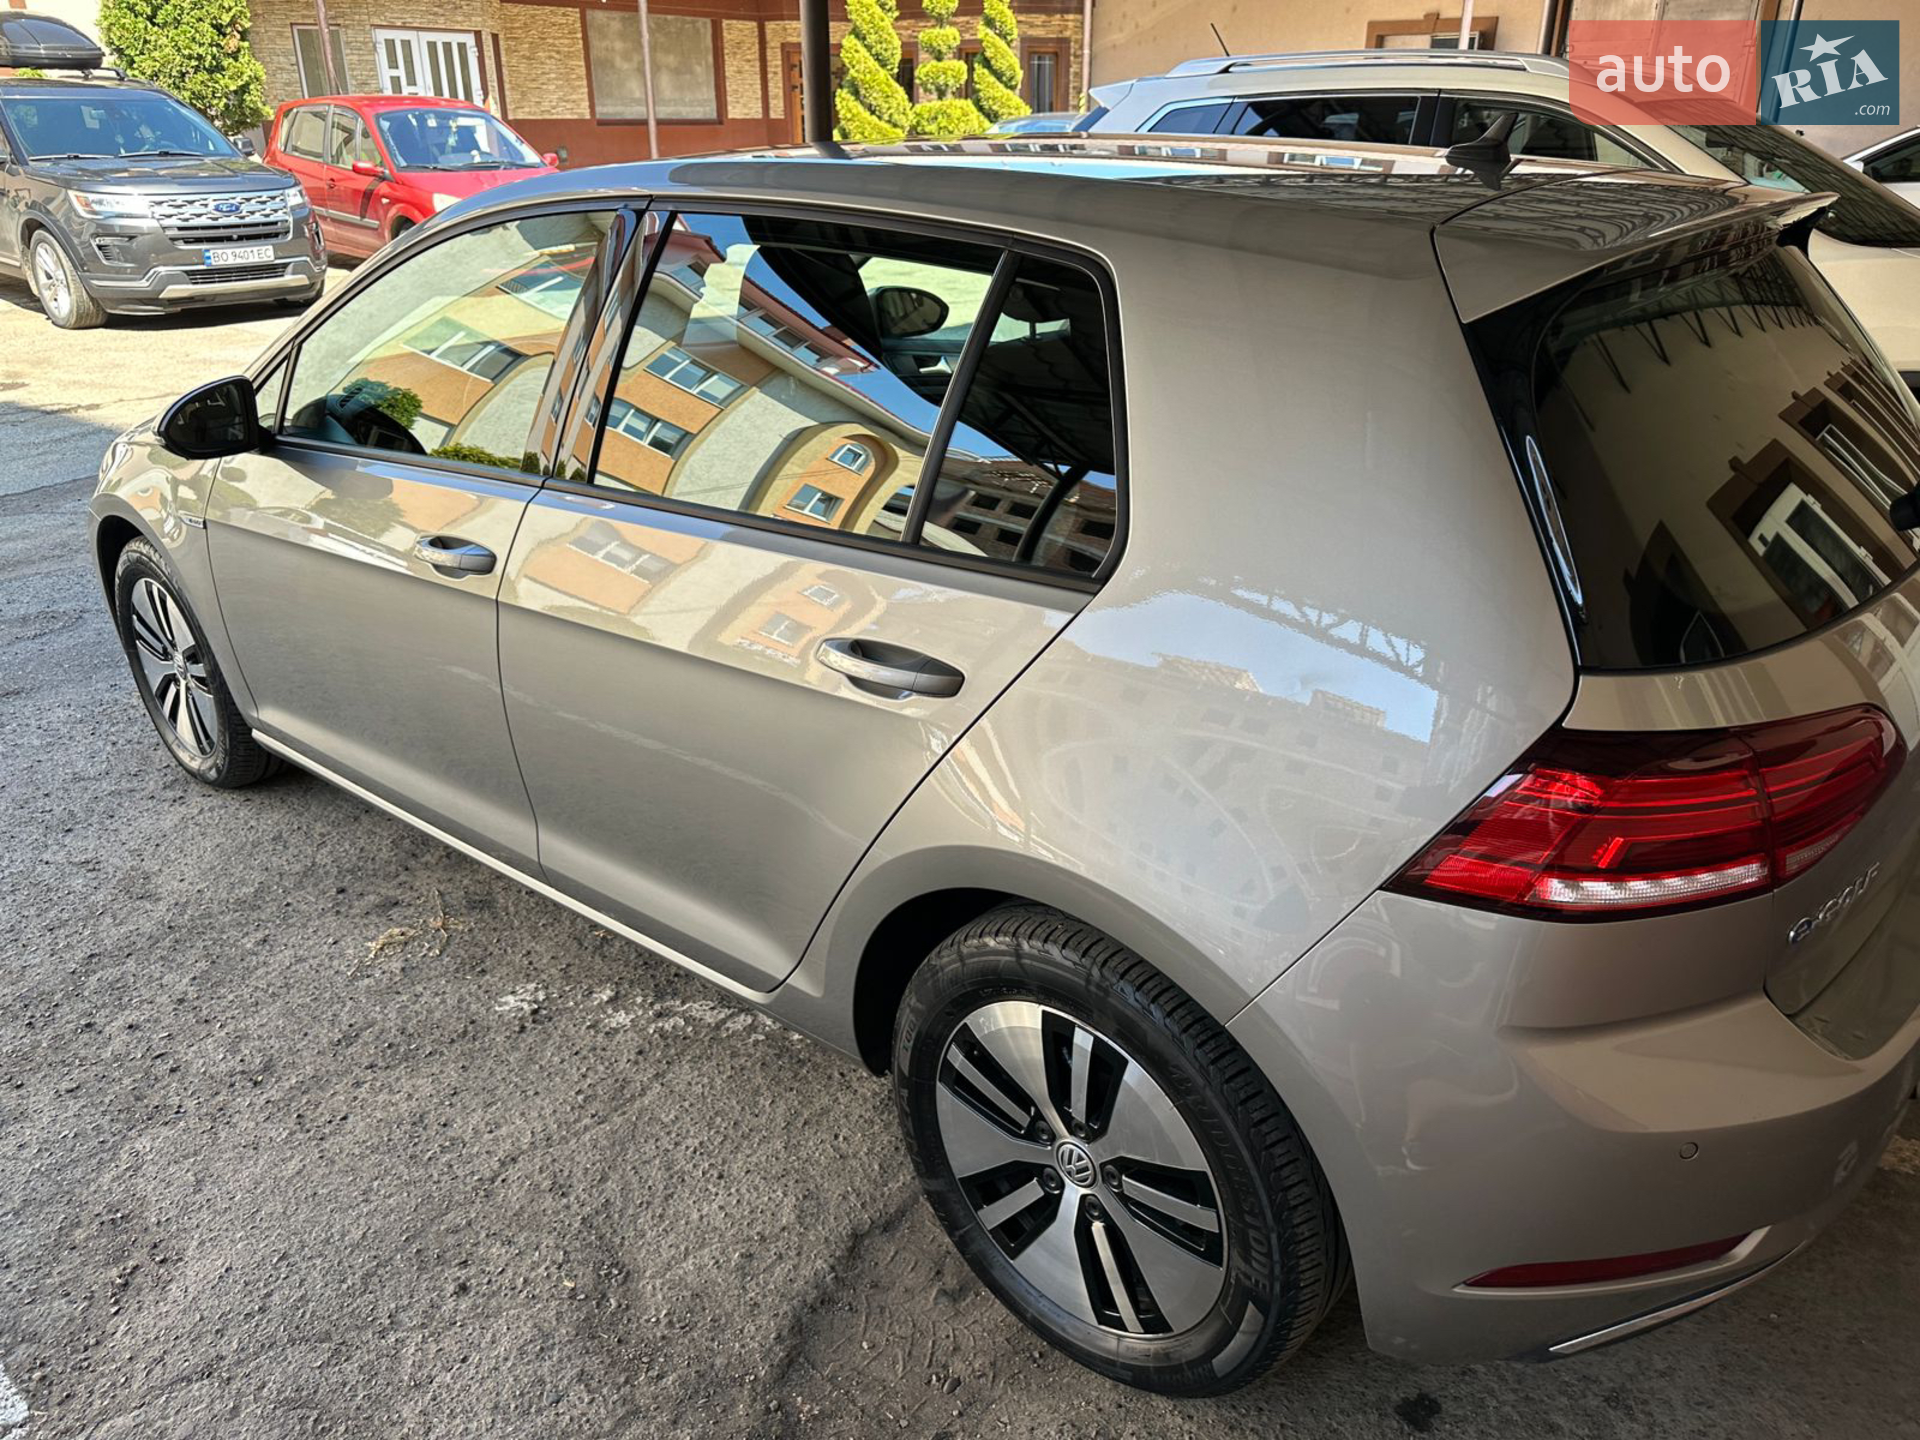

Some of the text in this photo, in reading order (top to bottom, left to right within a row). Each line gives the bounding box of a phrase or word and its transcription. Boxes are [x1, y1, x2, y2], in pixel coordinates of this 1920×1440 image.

[212, 248, 271, 262] BO 9401 EC
